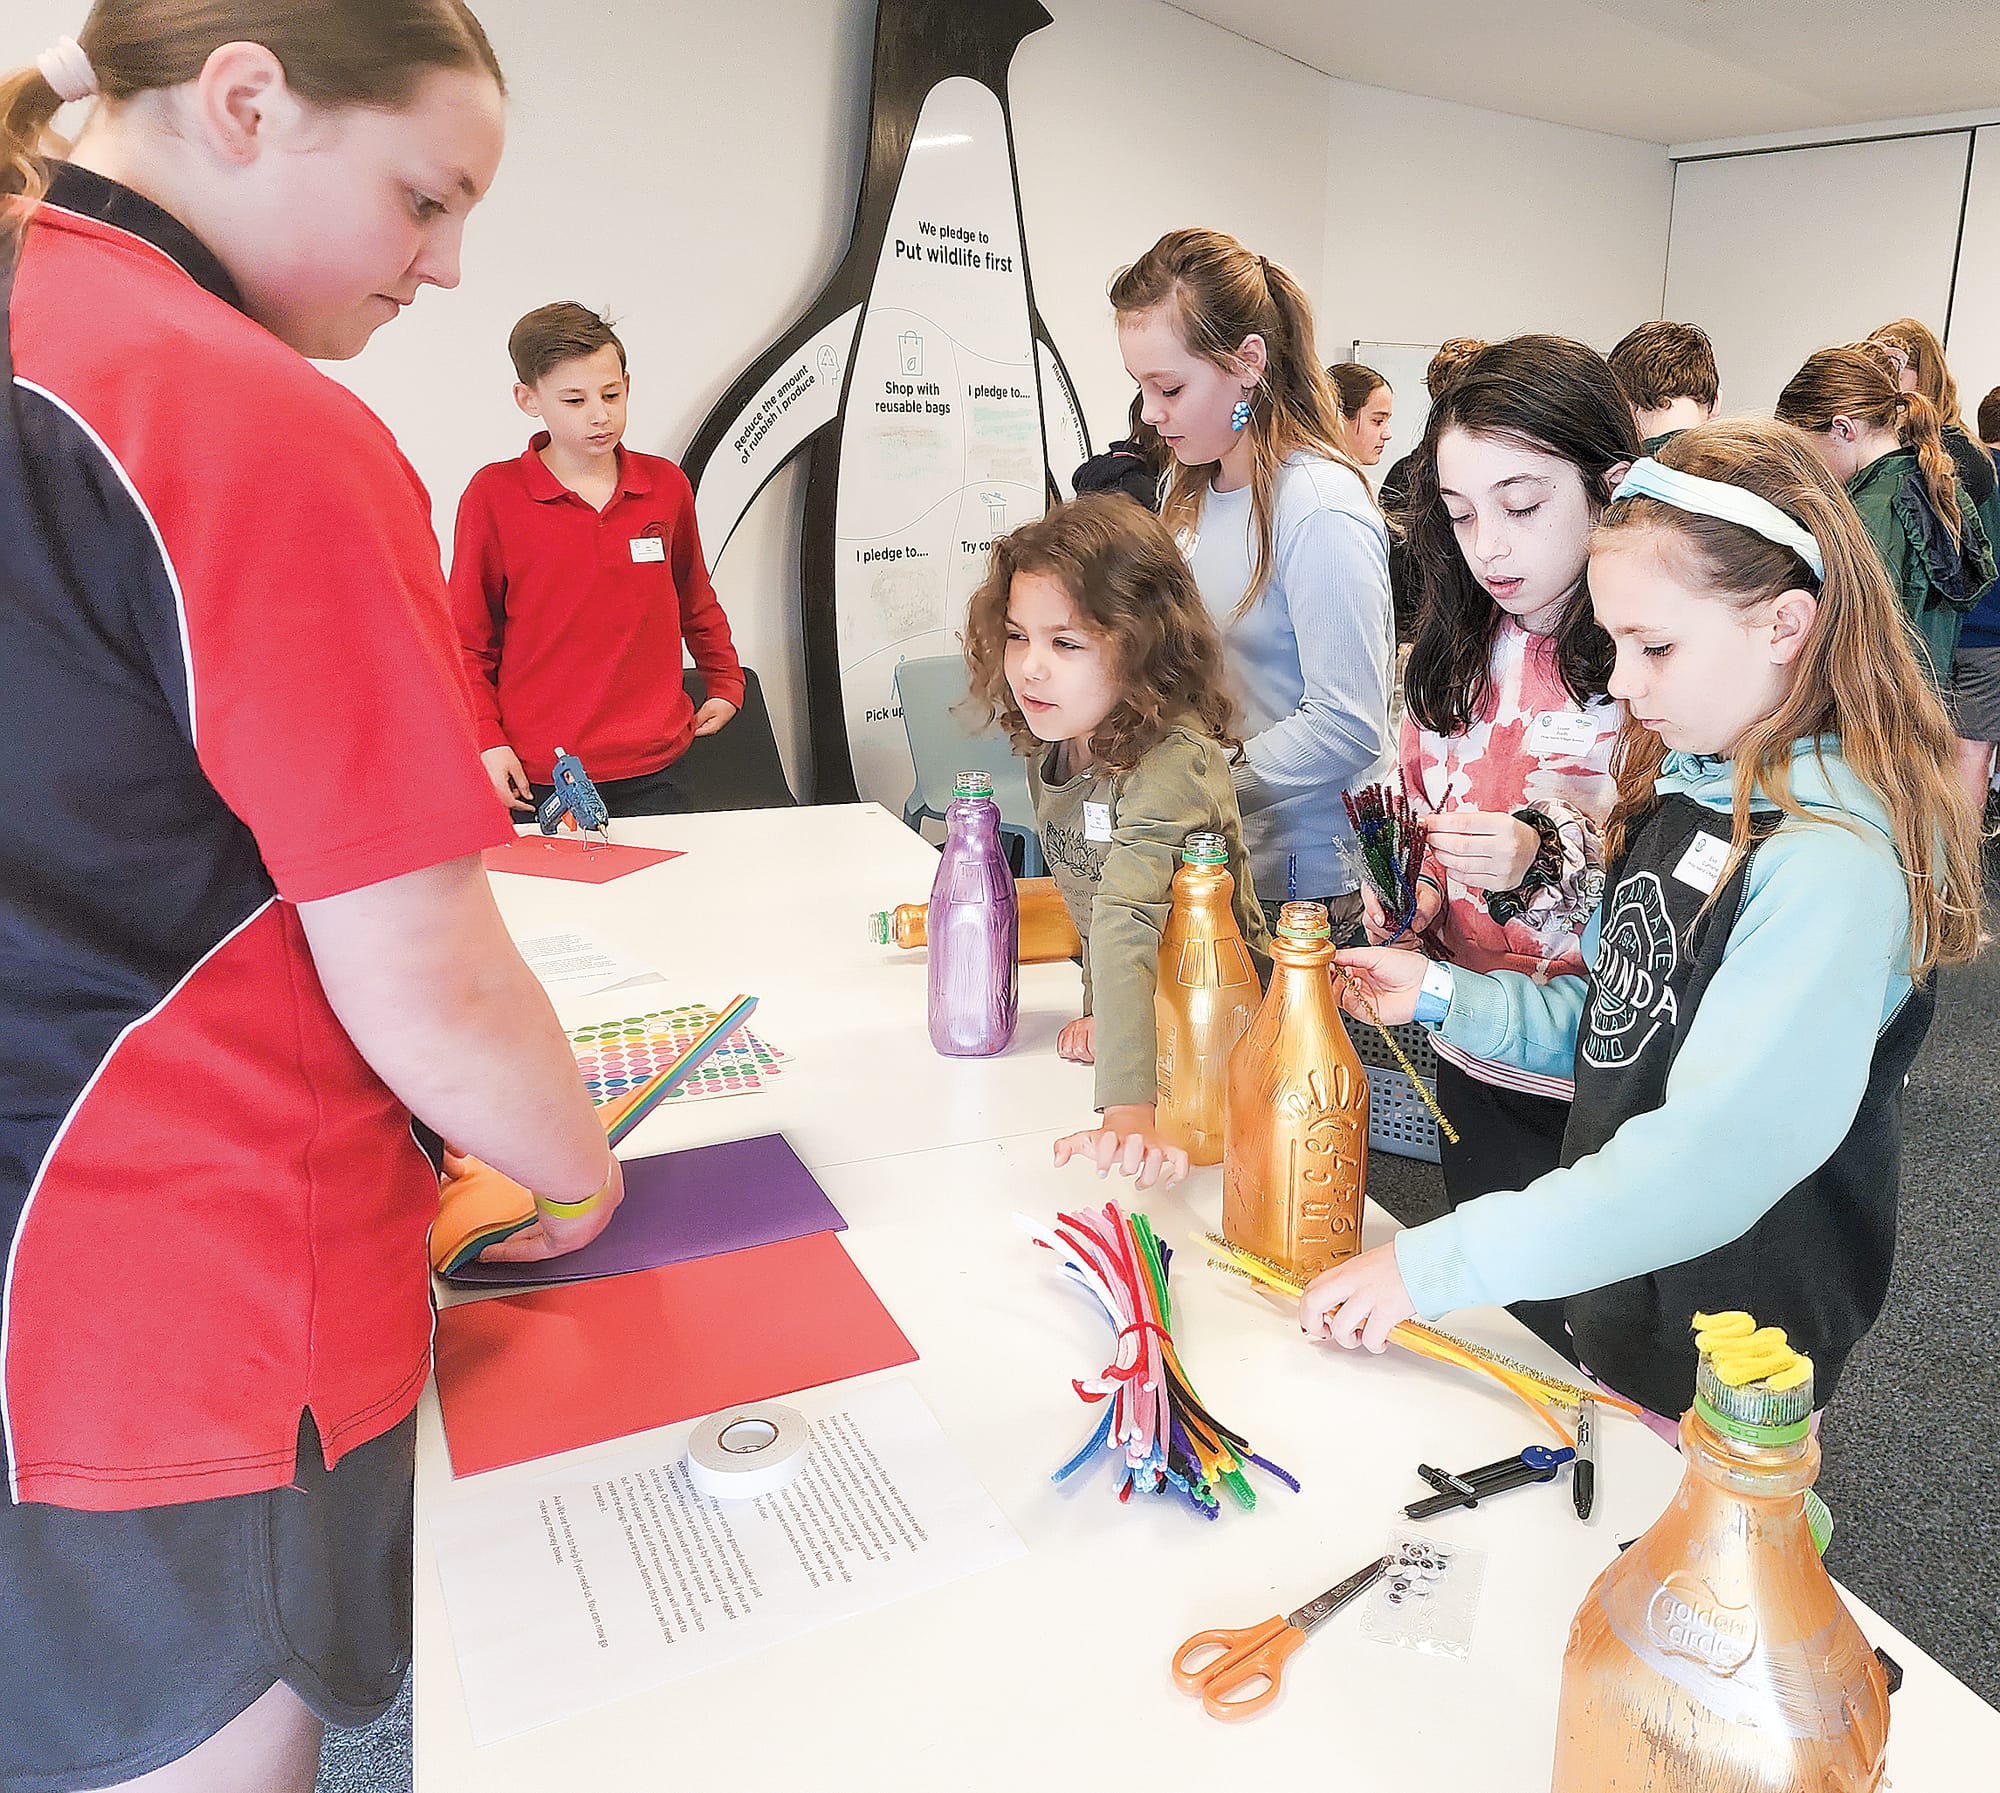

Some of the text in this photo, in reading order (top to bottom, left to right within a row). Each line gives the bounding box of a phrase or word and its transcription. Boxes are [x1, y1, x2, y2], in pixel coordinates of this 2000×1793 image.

[919, 221, 989, 244] We pledge to
[896, 240, 1012, 272] Put wildlife first
[885, 381, 940, 397] Shop with
[968, 385, 971, 396] I
[975, 385, 1007, 399] pledge
[734, 365, 809, 451] Reduce the amount
[875, 400, 950, 416] reusable bags
[741, 375, 815, 464] of rubbish I produce
[1077, 431, 1086, 459] much
[961, 541, 976, 553] Try
[856, 550, 860, 562] I
[864, 547, 902, 564] pledge
[866, 708, 889, 722] Pick
[1645, 886, 1672, 969] STATE
[1588, 1034, 1624, 1060] MIND
[778, 1487, 792, 1501] floor
[805, 1479, 820, 1493] there
[752, 1496, 764, 1507] the
[789, 1481, 812, 1508] something
[707, 1498, 722, 1512] they
[785, 1500, 796, 1513] near
[805, 1455, 817, 1466] you
[812, 1464, 826, 1477] have
[819, 1476, 832, 1491] some
[827, 1489, 846, 1511] random
[844, 1520, 864, 1542] change
[857, 1539, 875, 1560] around
[805, 1505, 818, 1518] and
[812, 1492, 832, 1515] because
[715, 1511, 724, 1521] are
[791, 1511, 804, 1522] the
[811, 1517, 821, 1527] are
[823, 1513, 839, 1528] they
[686, 1523, 704, 1544] picked
[705, 1524, 714, 1535] can
[723, 1526, 736, 1539] the
[797, 1520, 812, 1536] front
[814, 1525, 833, 1545] sitting
[832, 1525, 845, 1537] fell
[675, 1529, 690, 1548] based
[709, 1533, 721, 1545] eat
[767, 1499, 779, 1511] you
[774, 1508, 788, 1523] have
[781, 1521, 805, 1554] somewhere
[799, 1559, 814, 1572] put
[807, 1570, 823, 1588] them
[837, 1534, 850, 1546] out
[647, 1545, 660, 1558] the
[714, 1543, 728, 1560] them
[725, 1536, 746, 1560] ground
[825, 1542, 841, 1560] down
[660, 1542, 682, 1571] examples
[683, 1554, 701, 1575] saving
[703, 1556, 715, 1569] the
[813, 1549, 827, 1564] Now
[834, 1558, 847, 1570] the
[572, 1563, 584, 1576] you
[652, 1557, 668, 1585] resources
[708, 1567, 722, 1584] wind
[737, 1556, 755, 1579] outside
[840, 1568, 854, 1583] side
[578, 1574, 591, 1591] need
[691, 1573, 706, 1592] space
[722, 1565, 740, 1587] maybe
[821, 1569, 835, 1583] you
[660, 1584, 673, 1598] you
[677, 1577, 691, 1592] how
[714, 1581, 727, 1595] and
[748, 1584, 765, 1599] just
[630, 1549, 676, 1645] precut bottles that you will need
[667, 1595, 680, 1609] will
[680, 1590, 697, 1607] they
[700, 1589, 714, 1604] and
[733, 1590, 746, 1604] you
[586, 1598, 598, 1612] You
[689, 1604, 702, 1618] will
[717, 1593, 738, 1621] dragged
[740, 1602, 751, 1614] are
[590, 1611, 600, 1625] can
[672, 1606, 687, 1625] need
[1661, 1597, 1748, 1637] golden
[594, 1624, 605, 1640] now
[693, 1616, 708, 1633] turn
[1669, 1623, 1742, 1661] circle
